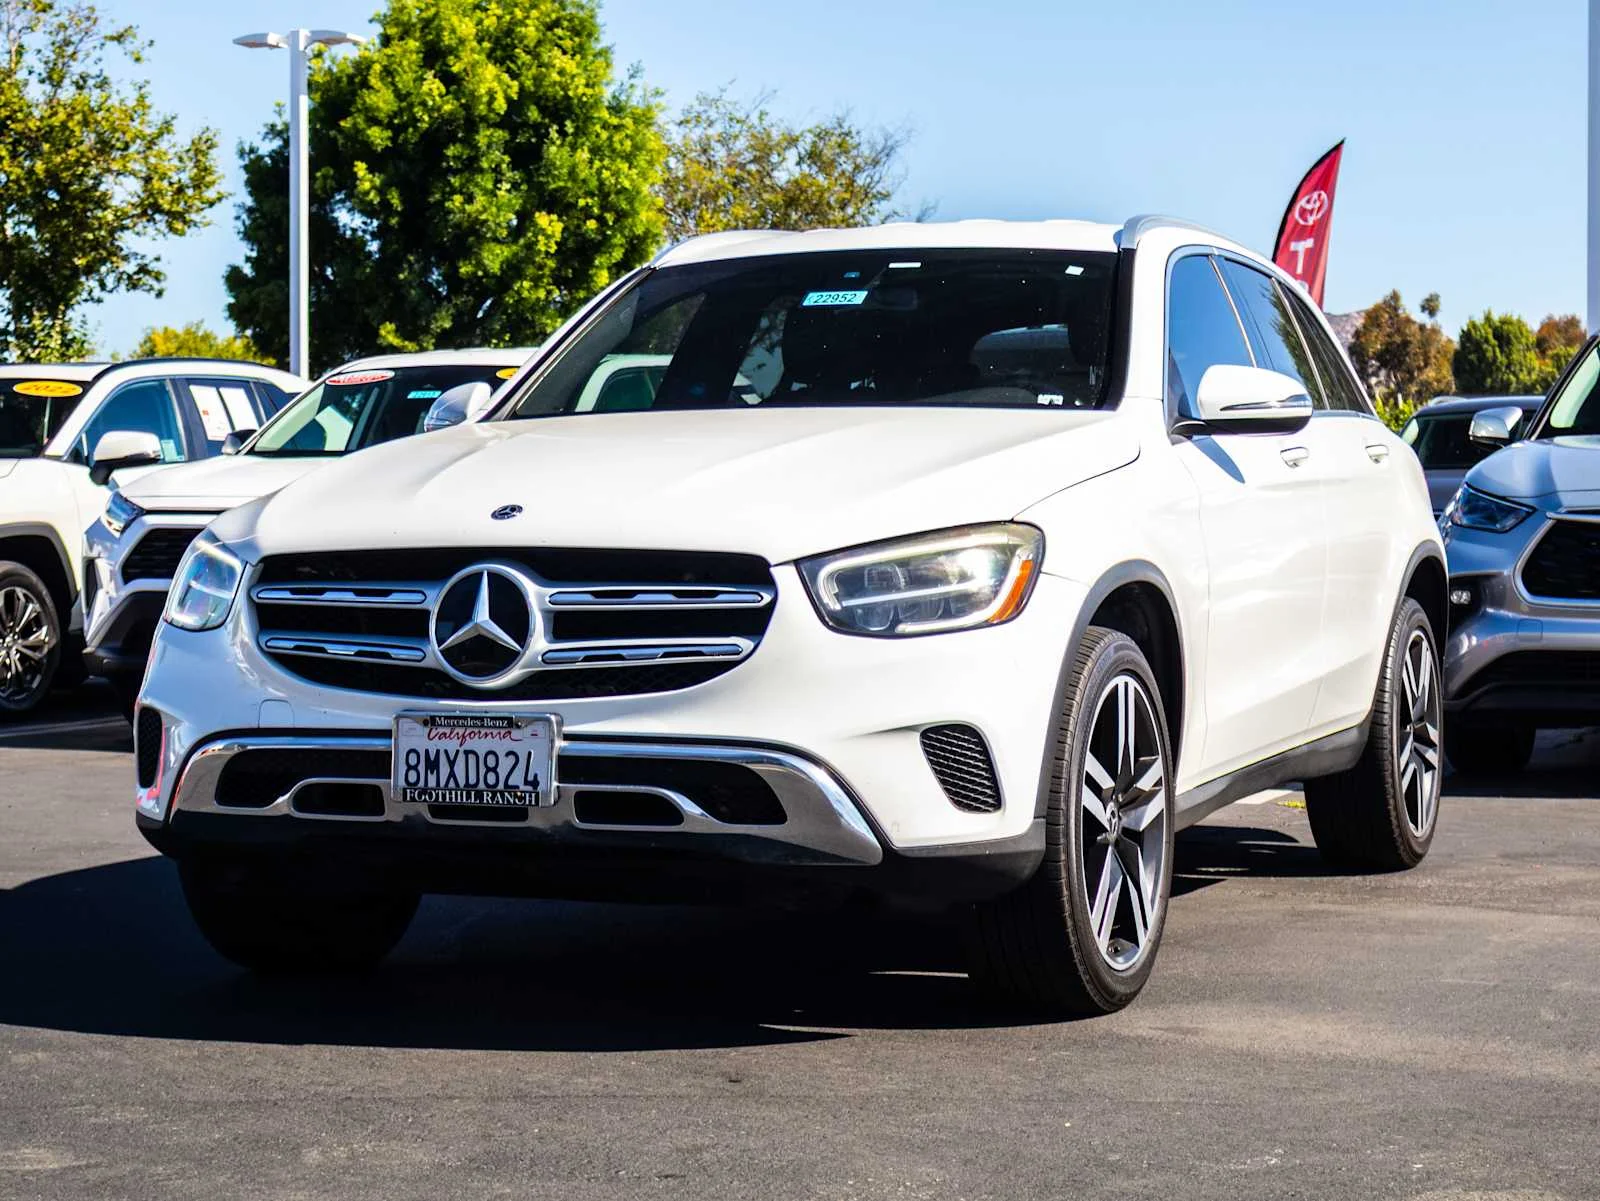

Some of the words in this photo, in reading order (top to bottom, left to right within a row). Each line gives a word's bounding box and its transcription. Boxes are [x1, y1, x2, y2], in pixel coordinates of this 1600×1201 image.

[813, 293, 857, 304] 22952
[435, 717, 509, 728] Mercedes-Benz
[427, 727, 523, 748] California
[404, 748, 541, 791] 8MXD824
[406, 789, 480, 804] FOOTHILL
[483, 791, 537, 806] RANCH
